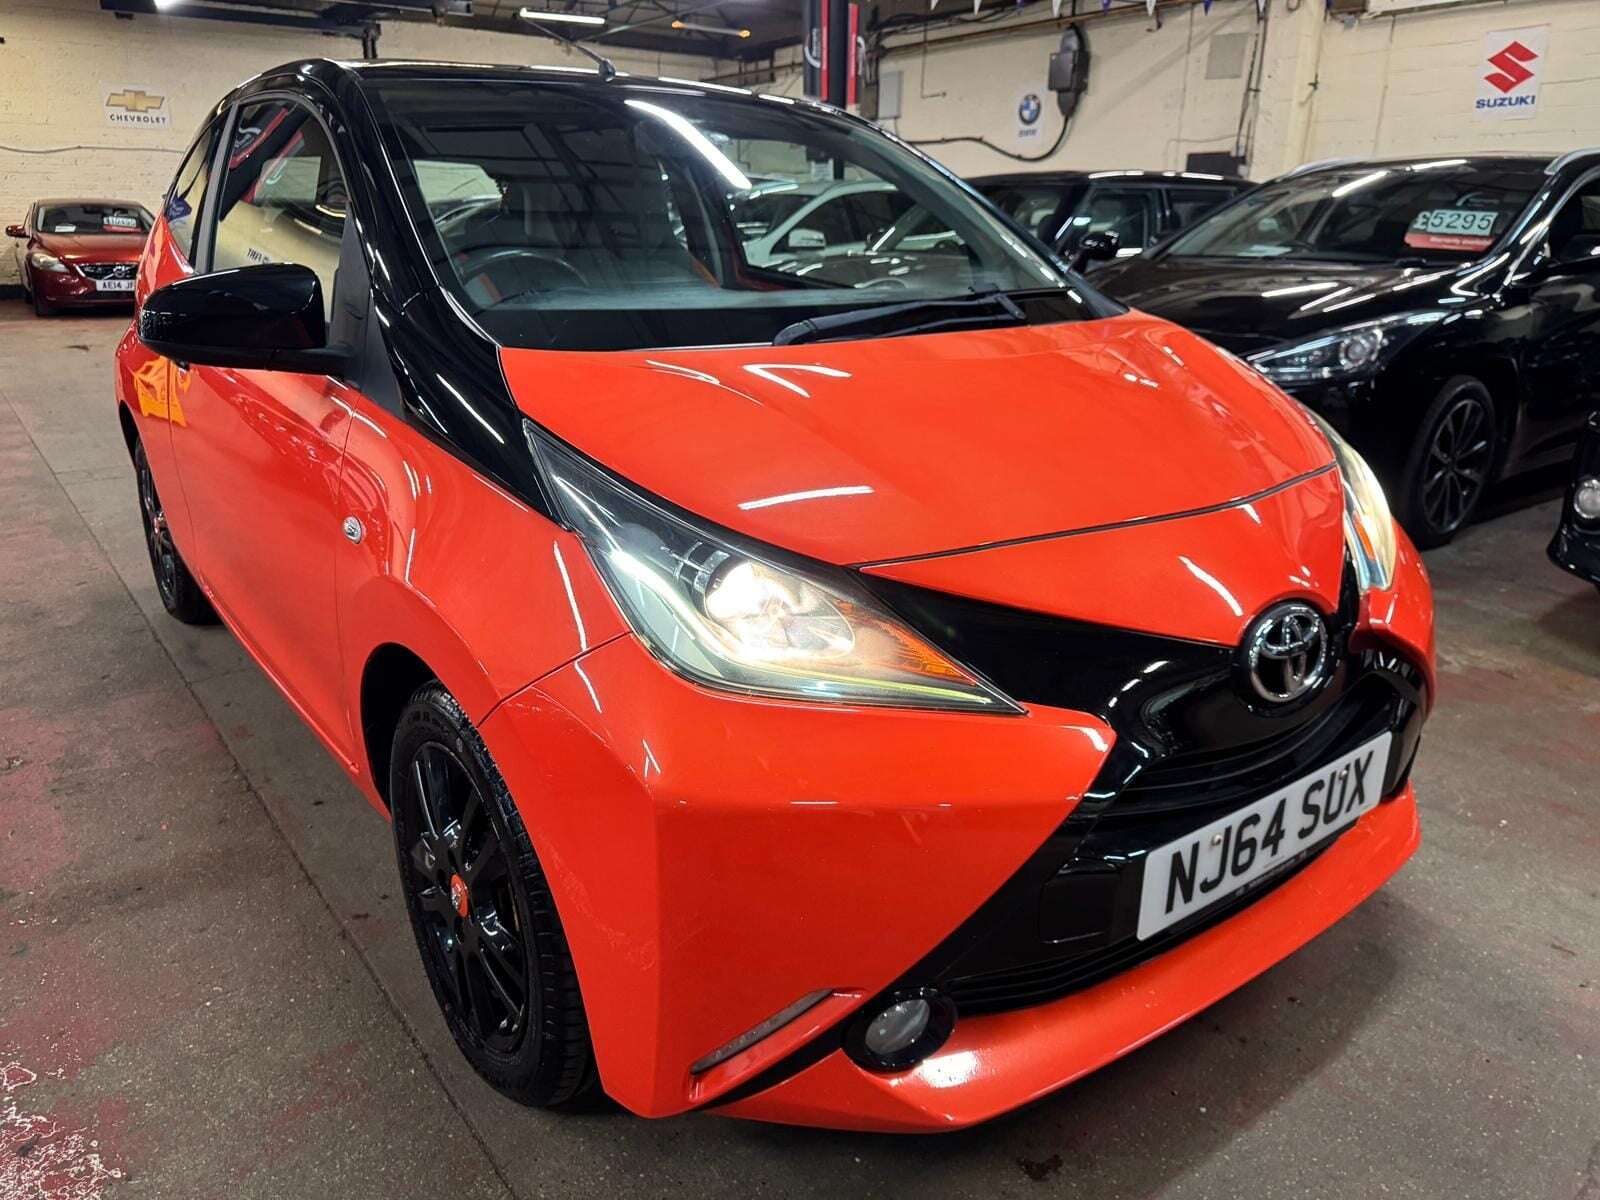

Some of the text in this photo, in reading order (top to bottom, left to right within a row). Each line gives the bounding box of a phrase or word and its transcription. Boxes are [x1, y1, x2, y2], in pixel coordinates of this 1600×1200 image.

[1475, 95, 1536, 109] SUZUKI
[109, 113, 166, 123] CHEVROLET
[1412, 211, 1494, 230] £5295
[1165, 797, 1287, 915] NJ64
[1297, 750, 1375, 840] SUX
